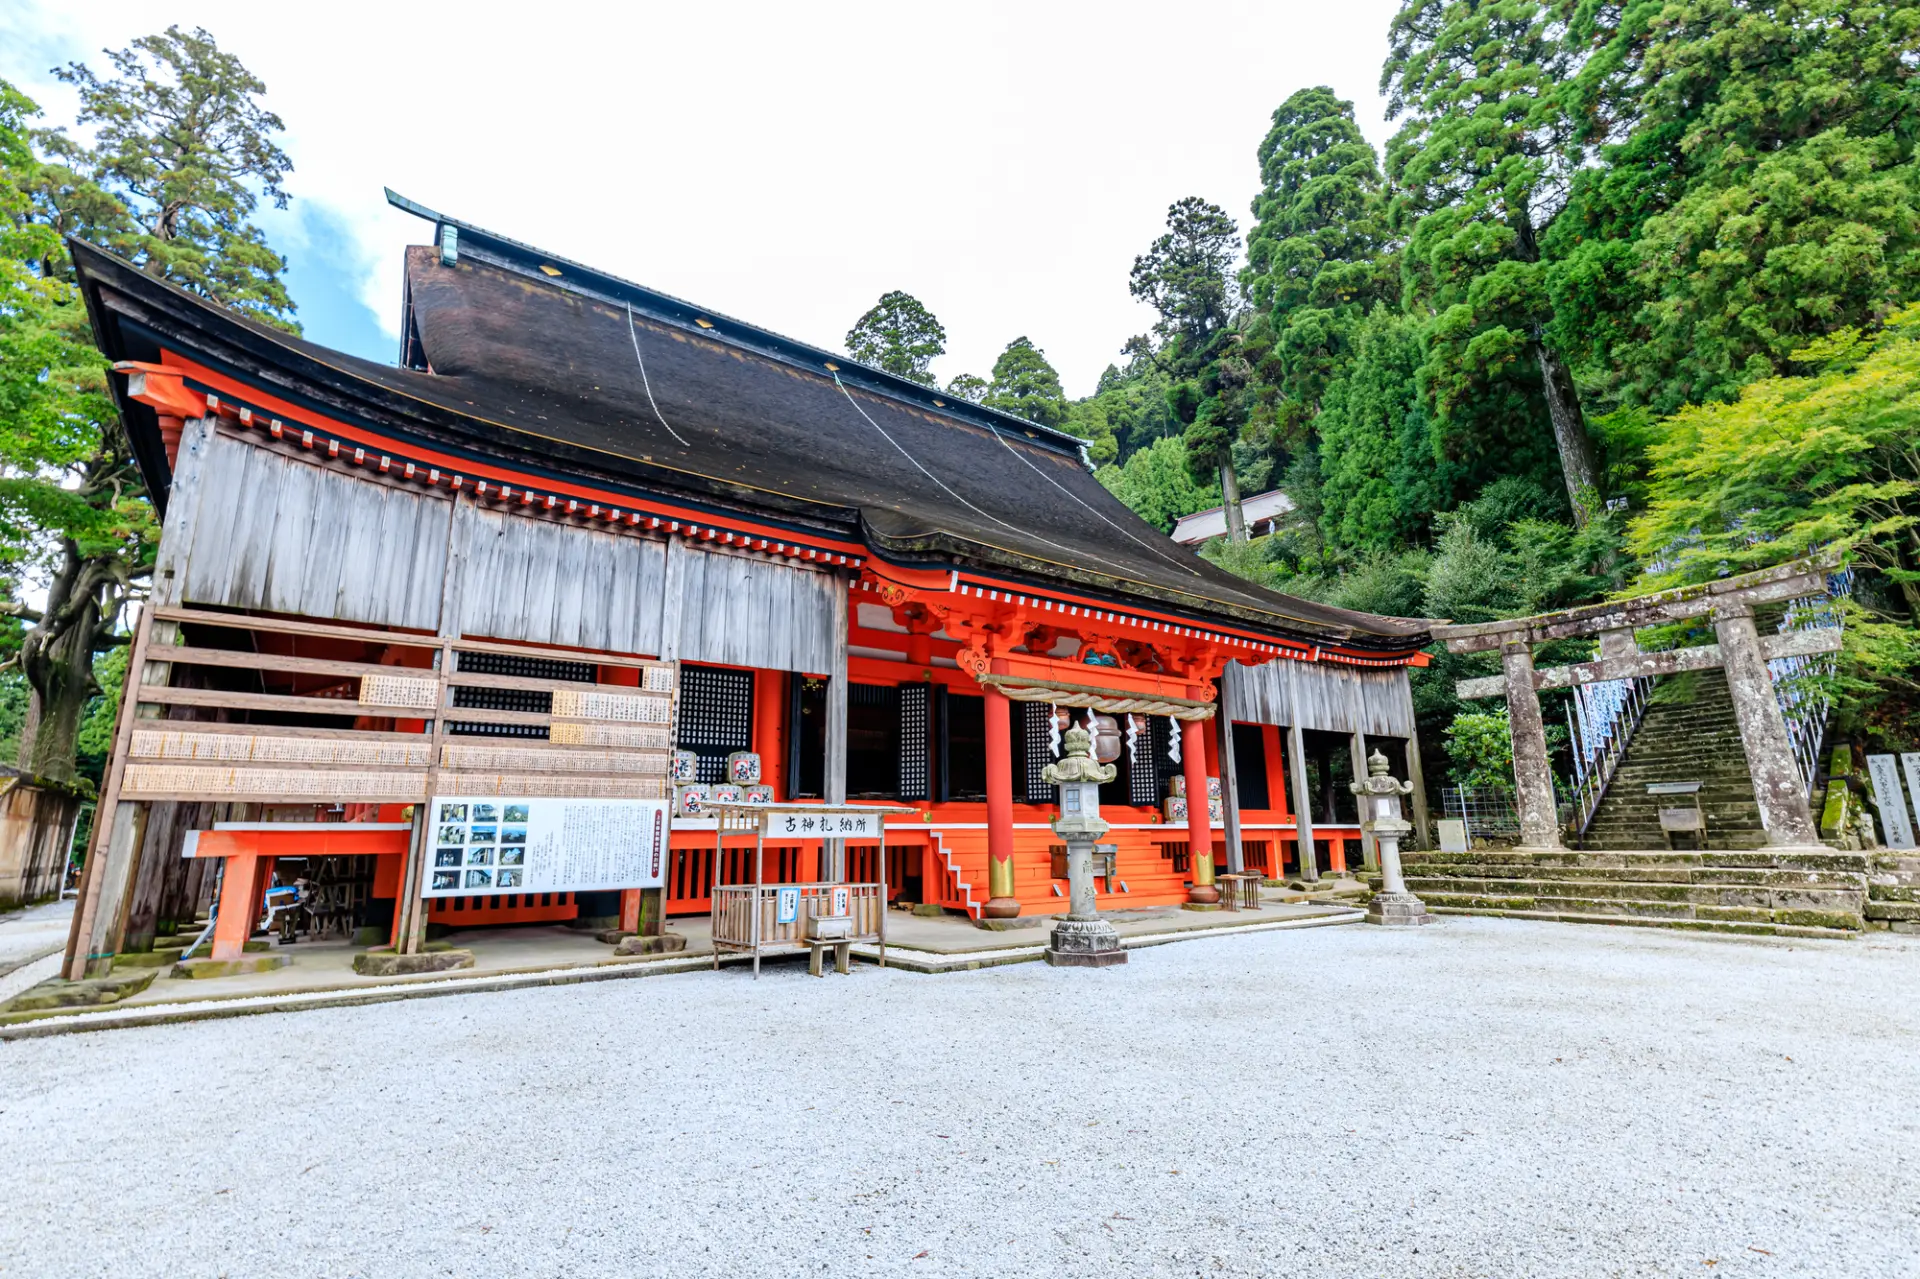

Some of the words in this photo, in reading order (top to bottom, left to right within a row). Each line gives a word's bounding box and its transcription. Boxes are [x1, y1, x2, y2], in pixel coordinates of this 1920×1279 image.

[785, 816, 867, 832] 古神札納所
